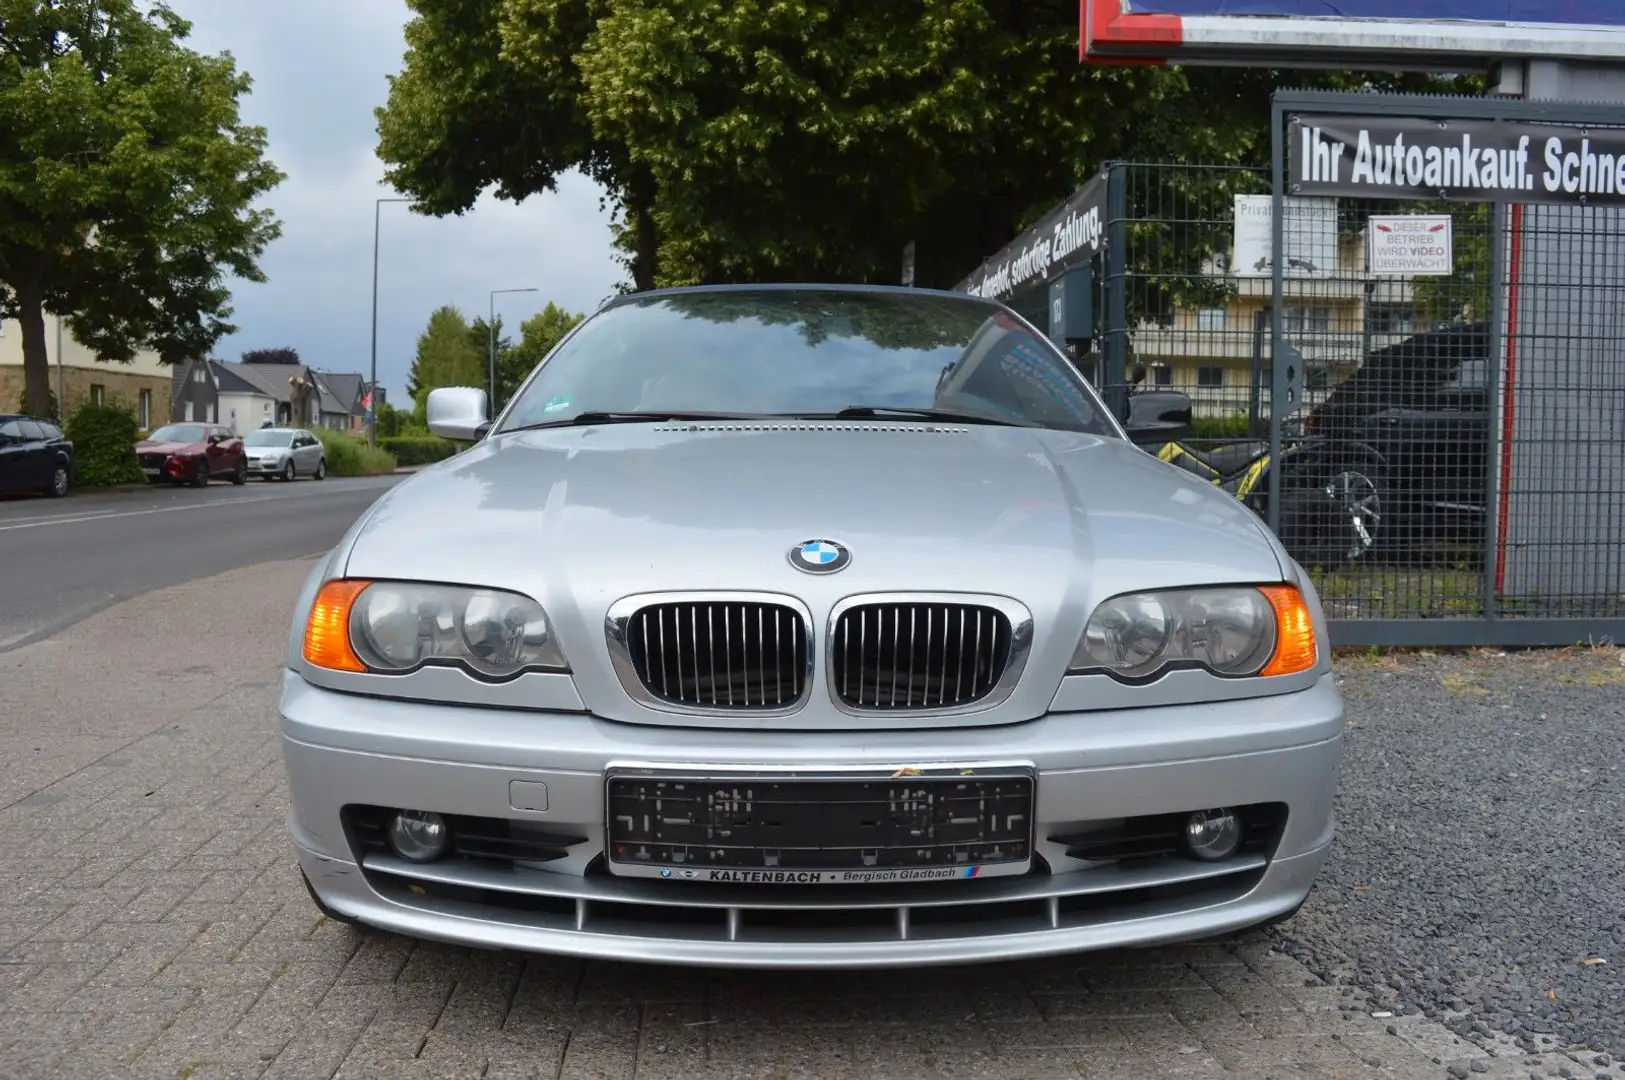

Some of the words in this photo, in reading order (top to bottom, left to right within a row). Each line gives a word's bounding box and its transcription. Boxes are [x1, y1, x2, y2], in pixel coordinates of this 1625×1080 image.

[1302, 127, 1345, 182] Ihr
[1351, 130, 1533, 190] Autoankauf.
[1393, 222, 1426, 232] DIESER
[1012, 237, 1051, 285] sofortige
[1052, 206, 1102, 262] Zahlung.
[1387, 234, 1434, 244] BETRIEB
[1377, 247, 1407, 256] WIRD
[1410, 247, 1444, 256] VIDEO
[709, 870, 821, 883] KALTENBACH
[843, 871, 897, 884] Bergisch
[900, 868, 956, 879] Gladbach
